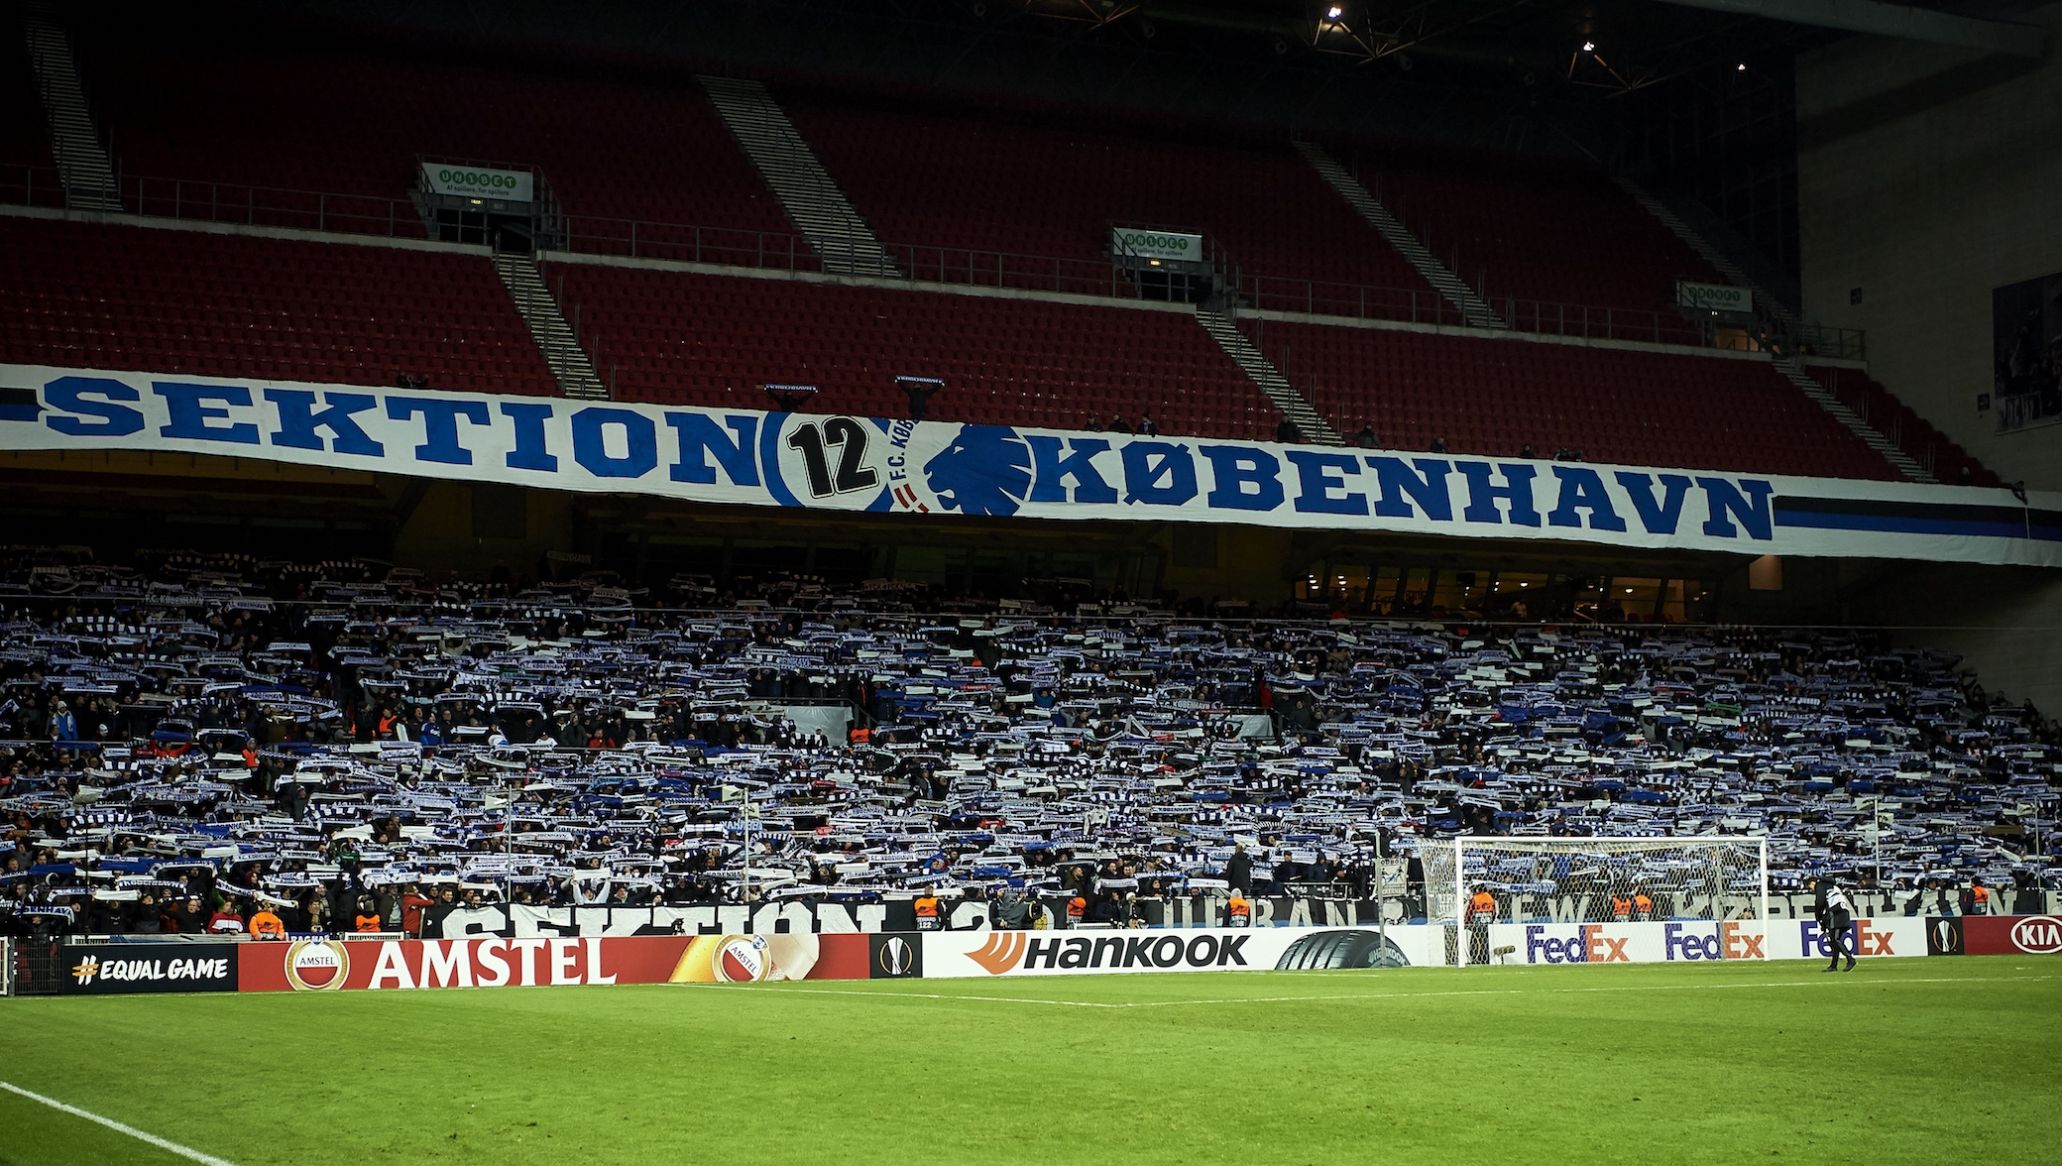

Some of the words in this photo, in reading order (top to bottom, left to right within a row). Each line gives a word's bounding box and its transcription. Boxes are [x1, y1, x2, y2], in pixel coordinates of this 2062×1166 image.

[440, 169, 517, 189] UNIBET
[1125, 233, 1188, 250] UNIBET
[44, 376, 761, 487] SEKTION
[786, 414, 880, 499] 12
[887, 452, 907, 481] F.C.
[1024, 434, 1775, 541] KØBENHAVN
[919, 921, 932, 929] 122
[2020, 924, 2062, 946] KIA
[1526, 924, 1630, 964] FedEx
[1664, 922, 1765, 961] FedEx
[72, 954, 165, 985] #EQUAL
[167, 958, 228, 981] GAME
[300, 956, 336, 966] AMSTEL
[367, 937, 617, 990] AMSTEL
[731, 946, 759, 974] AMSTEL
